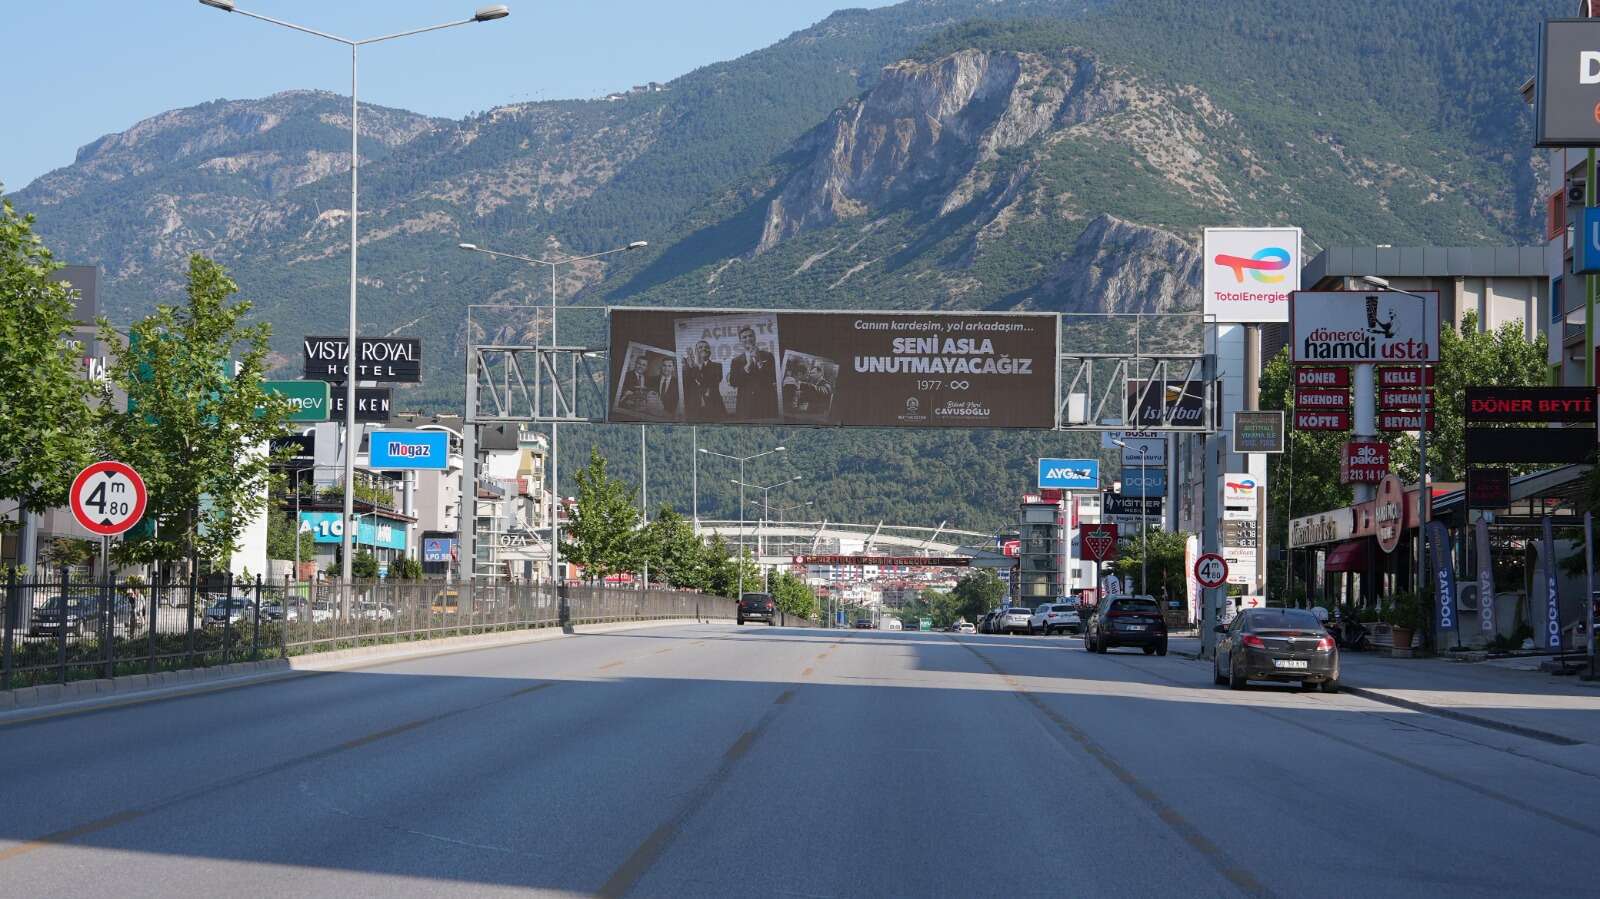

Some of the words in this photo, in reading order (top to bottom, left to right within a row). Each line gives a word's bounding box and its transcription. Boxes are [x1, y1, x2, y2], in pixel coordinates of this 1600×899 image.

[947, 320, 964, 333] yol
[1311, 328, 1366, 342] dönerci
[892, 334, 939, 354] SENİ
[941, 338, 994, 355] ASLA
[1304, 336, 1376, 359] hamdi
[1382, 338, 1429, 360] usta
[362, 342, 417, 362] ROYAL
[854, 354, 1033, 375] UNUTMAYACAĞIZ
[1299, 370, 1336, 384] DÖNER
[1384, 372, 1416, 383] KELLE
[916, 380, 941, 391] 1977
[1299, 393, 1344, 405] İSKENDER
[1471, 396, 1532, 412] DÖNER
[1299, 412, 1339, 427] KÖFTE
[388, 442, 430, 457] Mogaz
[1358, 446, 1376, 458] alo
[1350, 455, 1385, 466] paket
[1349, 469, 1364, 481] 213
[1366, 469, 1374, 481] 14
[85, 481, 106, 514] 4
[111, 482, 125, 493] m
[1201, 562, 1211, 579] 4
